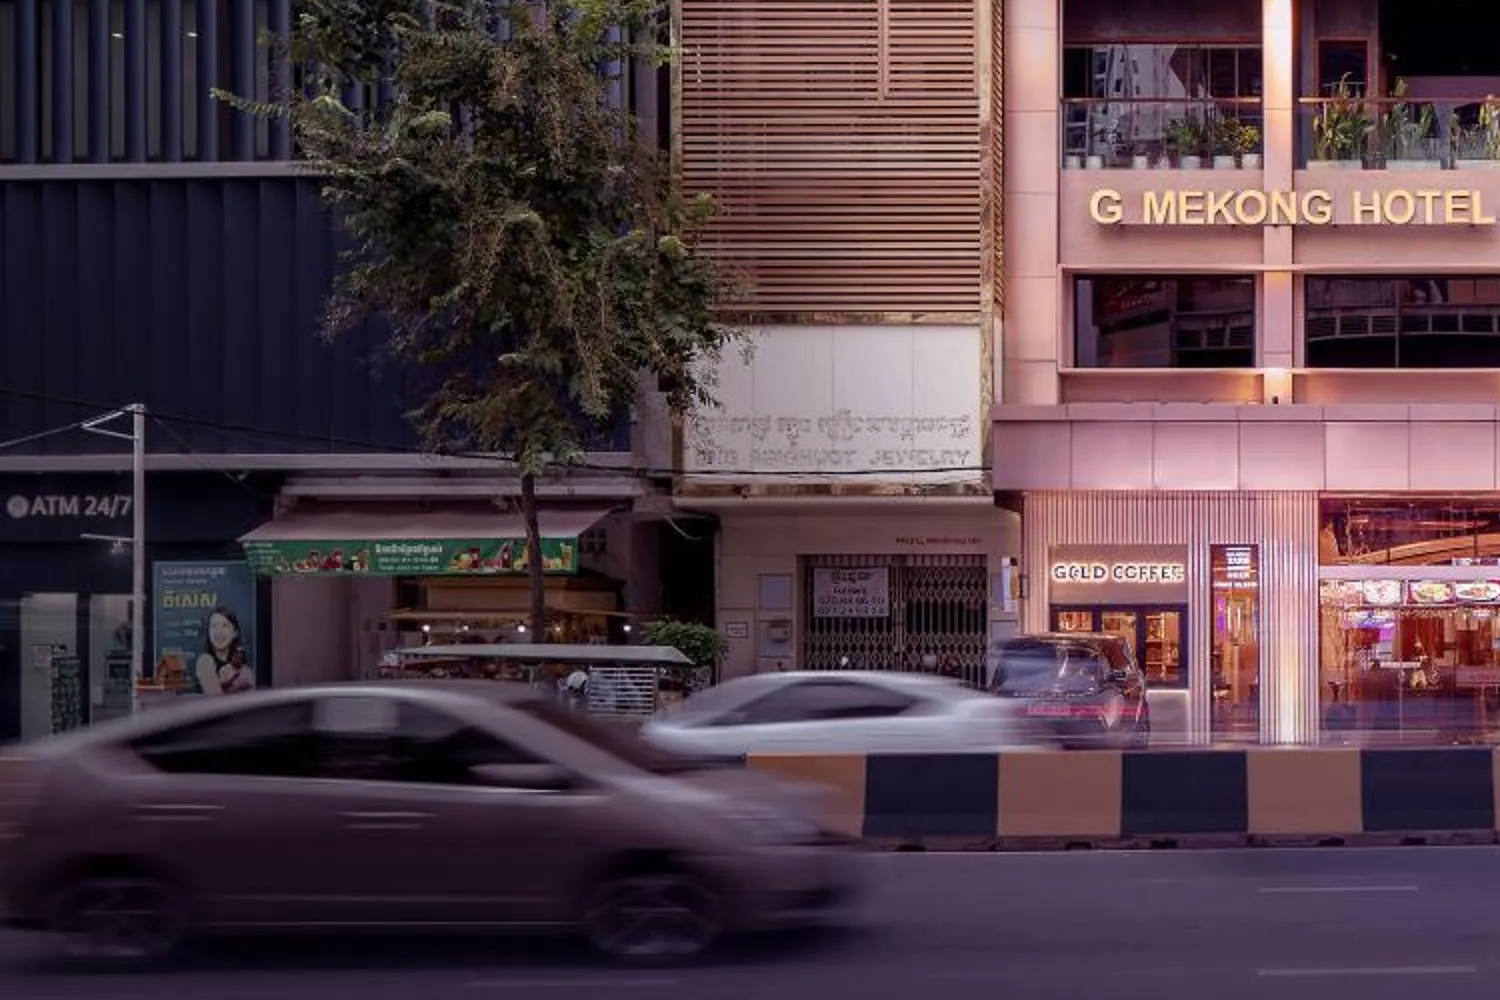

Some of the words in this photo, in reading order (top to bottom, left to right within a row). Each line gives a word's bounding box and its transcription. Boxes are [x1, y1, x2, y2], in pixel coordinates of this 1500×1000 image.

[1089, 188, 1122, 225] G
[1142, 189, 1332, 225] MEKONG
[1353, 188, 1496, 225] HOTEL
[31, 495, 79, 516] ATM
[84, 495, 132, 518] 24/7
[1053, 564, 1107, 581] GOLD
[1112, 564, 1185, 582] COFFEE
